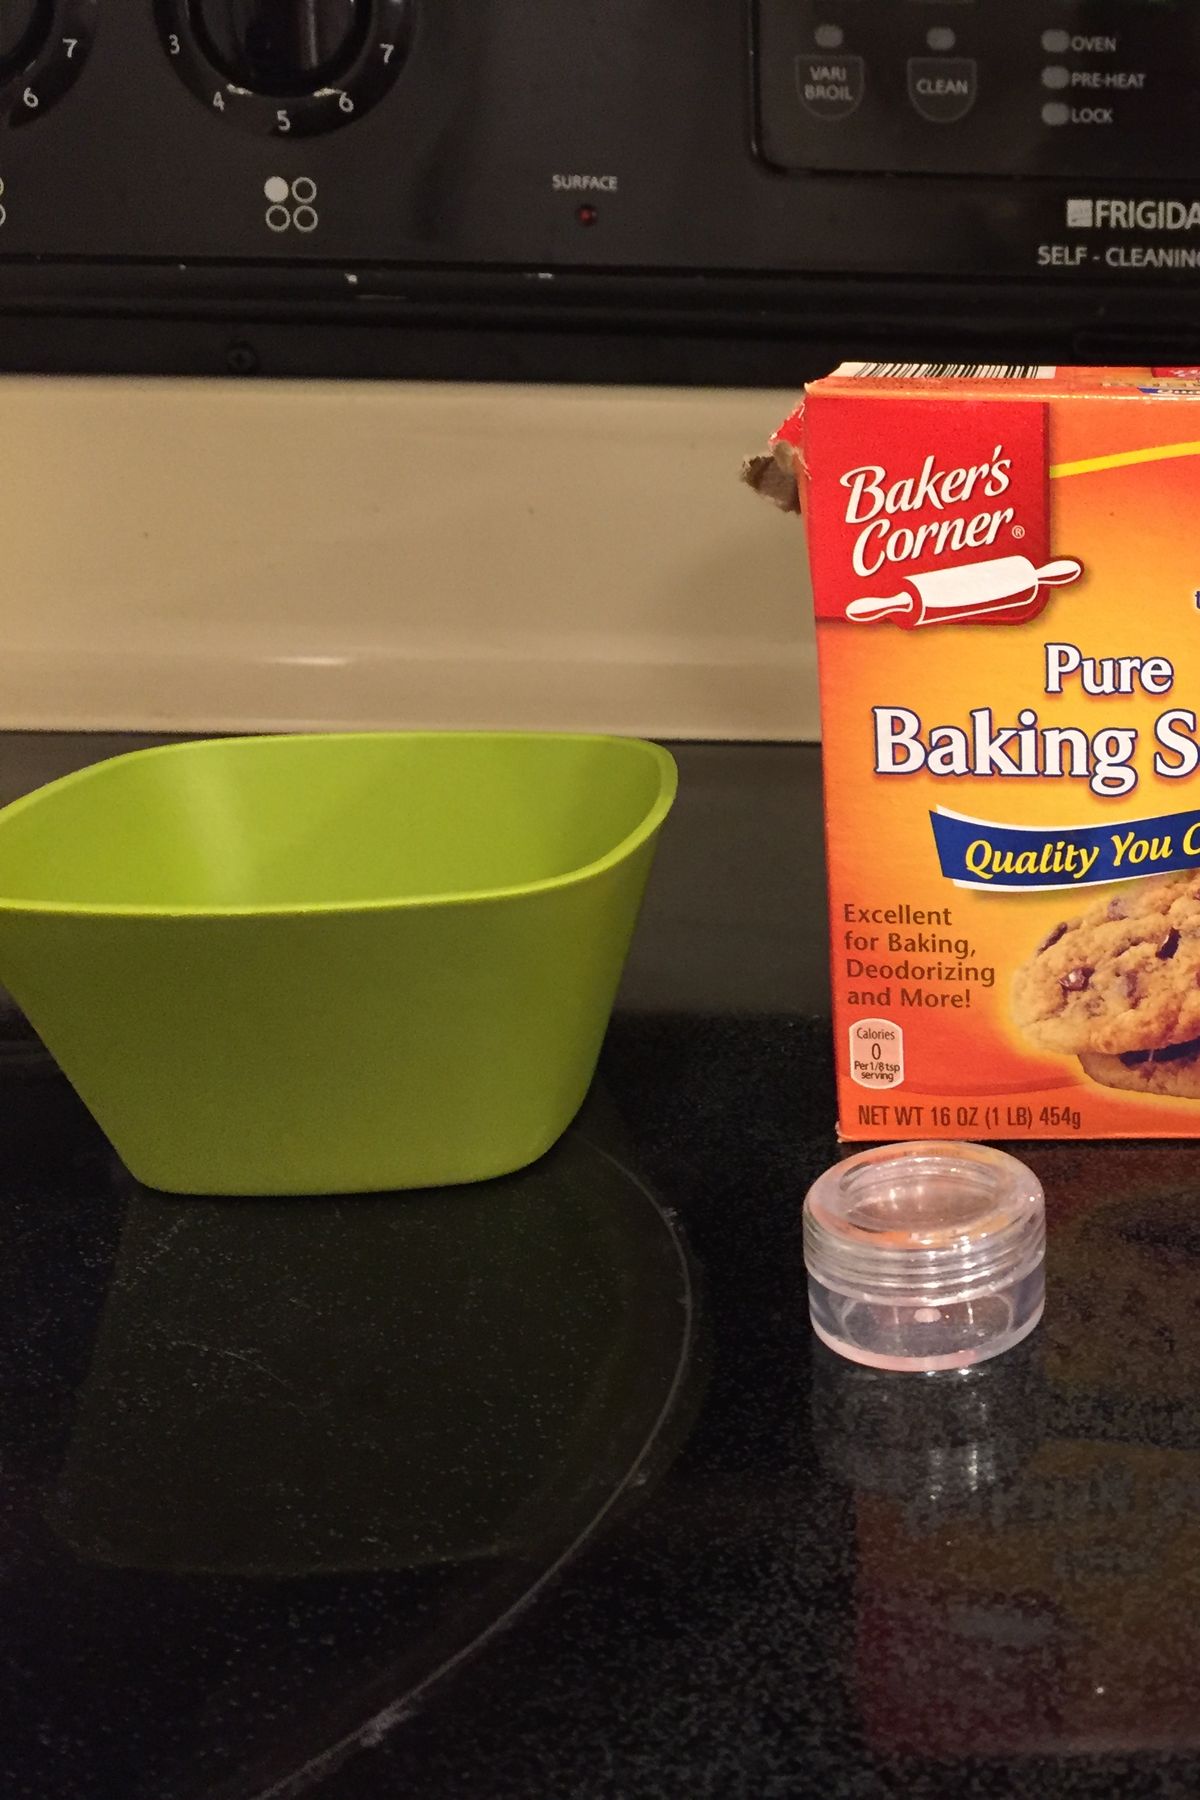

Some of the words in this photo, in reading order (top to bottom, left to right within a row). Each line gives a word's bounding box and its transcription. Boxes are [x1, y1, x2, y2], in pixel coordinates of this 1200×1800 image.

[62, 38, 78, 58] 7
[169, 34, 181, 55] 3
[380, 43, 395, 64] 7
[1071, 35, 1117, 52] OVEN
[809, 66, 847, 81] VARI
[1071, 73, 1145, 89] PRE-HEAT
[804, 84, 853, 100] BROIL
[916, 78, 968, 95] CLEAN
[23, 87, 39, 108] 6
[212, 92, 225, 112] 4
[339, 93, 354, 114] 6
[277, 110, 291, 131] 5
[1071, 107, 1113, 124] LOCK
[551, 173, 618, 192] SURFACE
[1038, 246, 1088, 265] SELF
[839, 445, 1012, 525] Baker's
[852, 508, 1015, 577] Corner
[1045, 643, 1174, 695] Pure
[872, 706, 1137, 797] Baking
[965, 839, 1099, 879] Quality
[1111, 832, 1176, 868] You
[843, 903, 952, 926] Excellent
[844, 931, 879, 953] for
[887, 933, 977, 960] Baking,
[846, 959, 996, 987] Deodorizing
[848, 985, 892, 1007] and
[900, 987, 972, 1009] More!
[856, 1026, 896, 1041] Calories
[871, 1043, 882, 1060] 0
[854, 1060, 869, 1071] Per
[885, 1062, 900, 1073] tsp
[861, 1071, 894, 1083] serving
[858, 1105, 890, 1126] NET
[895, 1106, 924, 1127] WT
[930, 1106, 950, 1127] 16
[957, 1106, 979, 1127] OZ
[985, 1105, 999, 1130] (1
[1007, 1105, 1033, 1130] LB)
[1039, 1106, 1082, 1130] 454g
